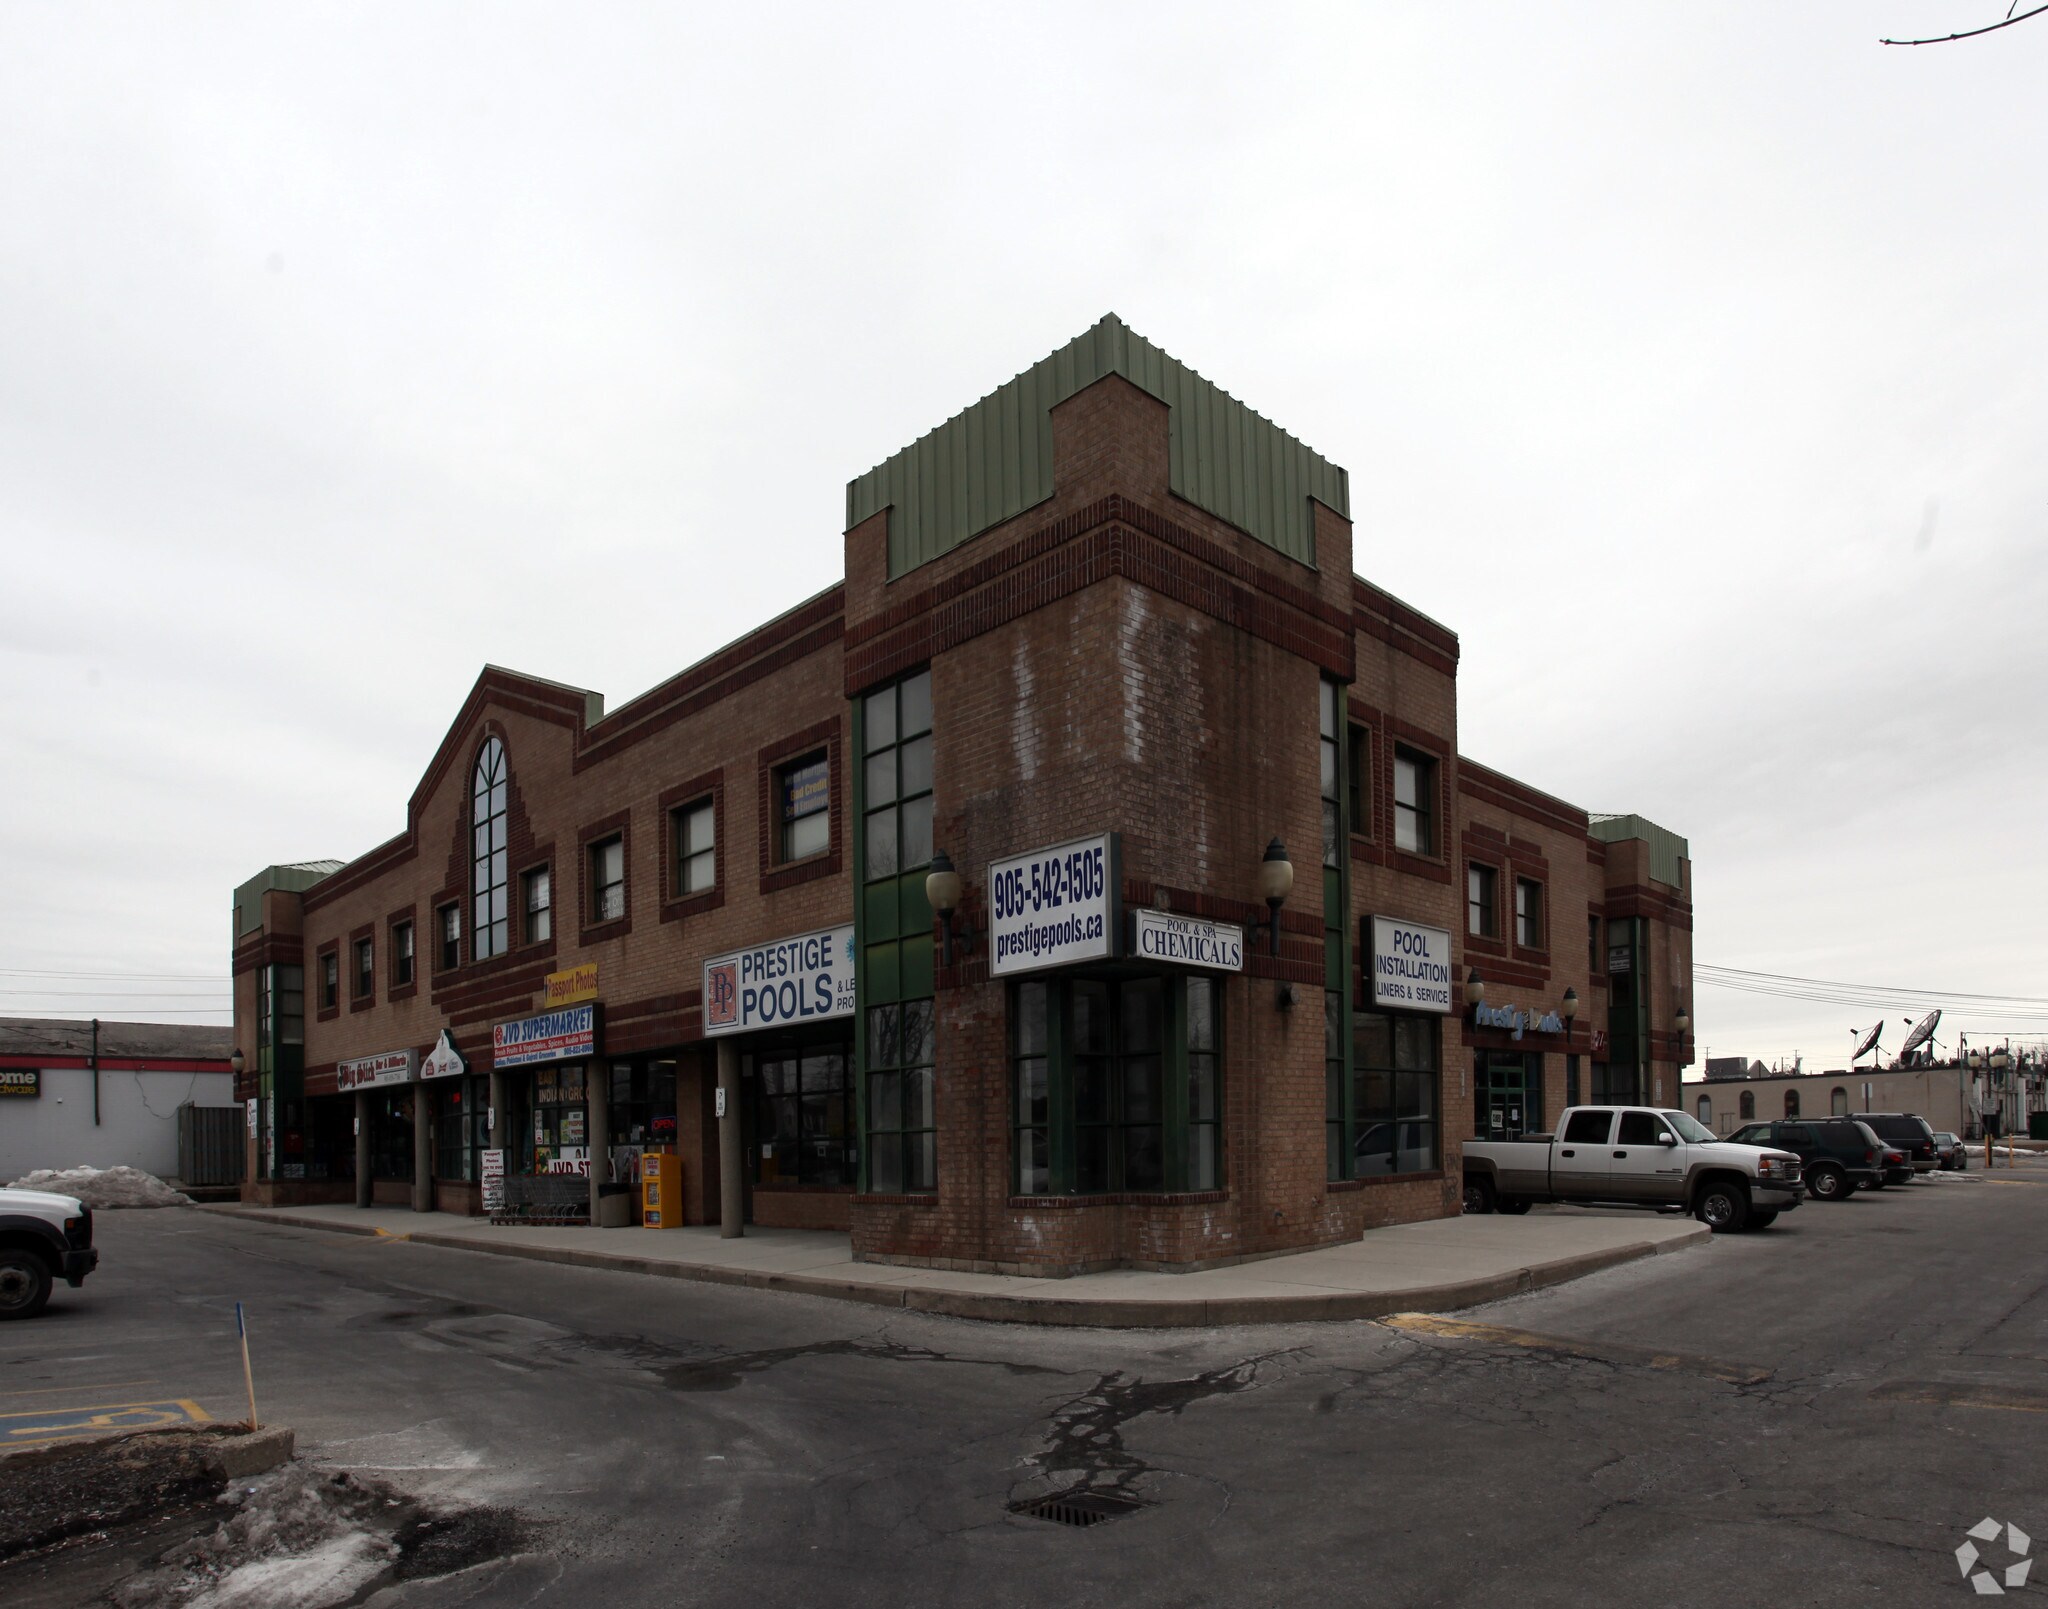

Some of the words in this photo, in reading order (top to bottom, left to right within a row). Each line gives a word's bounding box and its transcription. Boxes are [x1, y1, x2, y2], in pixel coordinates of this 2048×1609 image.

[994, 847, 1104, 919] 905-542-1505
[997, 913, 1103, 963] prestigepools.ca
[1167, 919, 1190, 935] POOL
[1193, 923, 1200, 936] &
[1202, 926, 1217, 939] SPA
[1394, 929, 1430, 958] POOL
[742, 935, 833, 984] PRESTIGE
[1142, 928, 1240, 966] CHEMICALS
[1376, 954, 1448, 983] INSTALLATION
[548, 973, 575, 1001] Passport
[576, 969, 598, 993] Photos
[742, 973, 833, 1025] POOLS
[837, 980, 843, 993] &
[1377, 981, 1405, 999] LINERS
[1407, 986, 1413, 999] &
[1416, 987, 1448, 1004] SERVICE
[503, 1022, 520, 1045] JVD
[522, 1006, 593, 1042] SUPERMARKET
[495, 1048, 506, 1057] Fresh
[506, 1046, 519, 1055] Fruits
[565, 1036, 579, 1044] Audio
[579, 1033, 593, 1042] Video
[654, 1119, 675, 1130] OPEN
